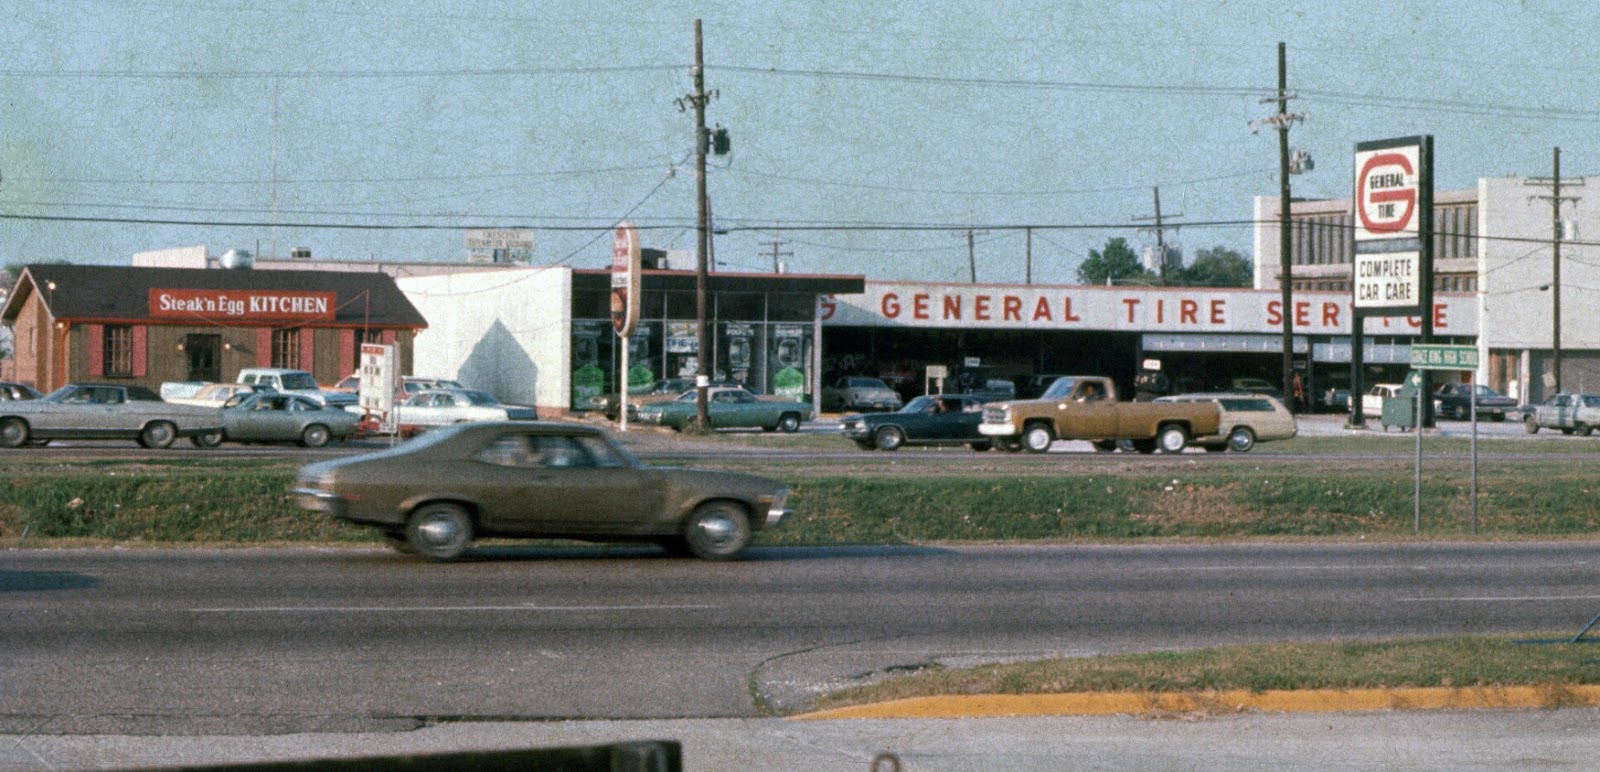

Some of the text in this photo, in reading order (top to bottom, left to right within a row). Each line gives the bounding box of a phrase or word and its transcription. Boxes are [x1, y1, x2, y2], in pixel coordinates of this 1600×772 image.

[1369, 172, 1405, 190] GENERAL
[1378, 203, 1396, 219] TIRE
[1359, 259, 1412, 278] COMPLETE
[1359, 282, 1411, 301] CAR CARE
[218, 296, 245, 315] Egg
[249, 297, 328, 313] KITCHEN
[881, 292, 1080, 322] GENERAL
[1122, 299, 1226, 324] TIRE
[1266, 301, 1448, 328] SERE
